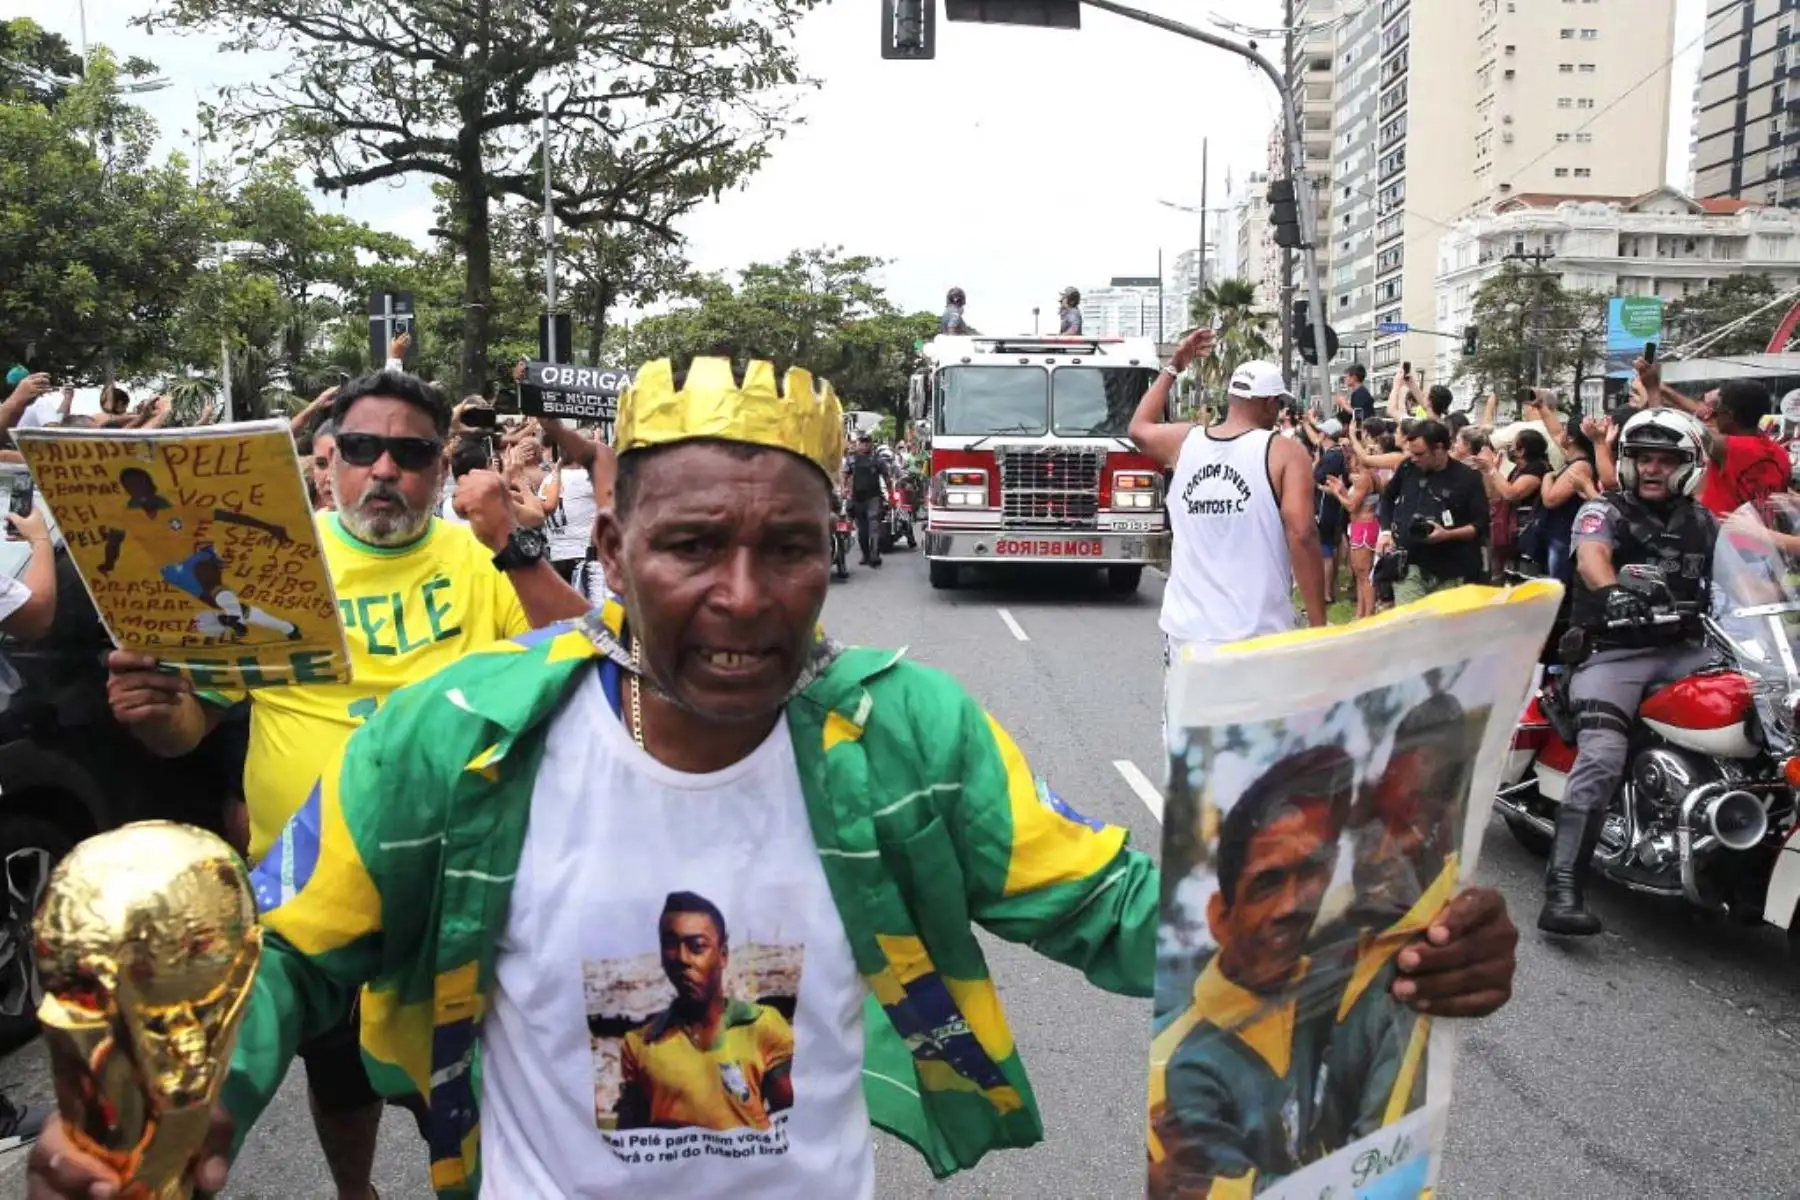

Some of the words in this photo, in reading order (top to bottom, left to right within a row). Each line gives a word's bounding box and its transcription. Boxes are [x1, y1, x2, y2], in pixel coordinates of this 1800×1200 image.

[541, 366, 632, 391] OBRIGA
[565, 391, 618, 407] NÚCLE
[543, 402, 618, 418] SOROCAB
[158, 650, 338, 690] ELE
[666, 1133, 698, 1149] para
[645, 1153, 655, 1162] o
[682, 1146, 701, 1158] do
